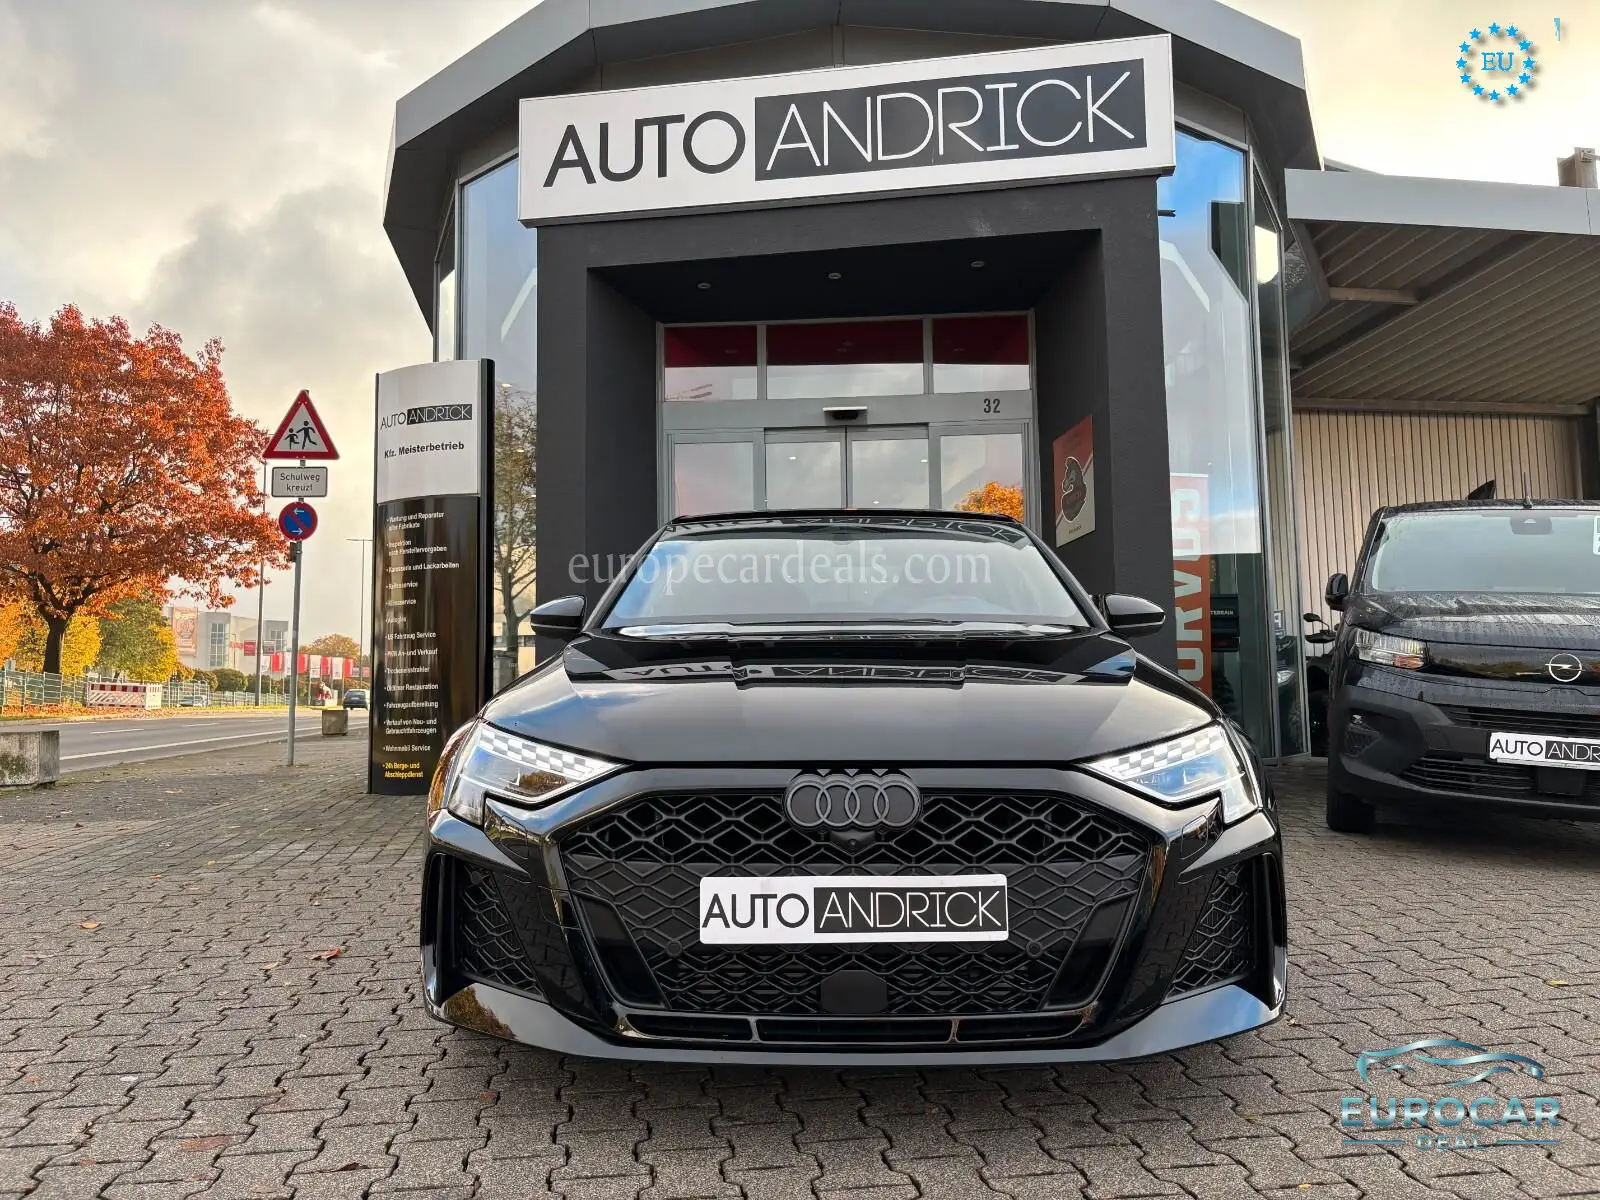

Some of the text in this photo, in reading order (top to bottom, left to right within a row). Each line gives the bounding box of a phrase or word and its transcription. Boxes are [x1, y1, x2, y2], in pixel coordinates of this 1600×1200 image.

[543, 71, 1135, 188] AUTO ANDRICK
[983, 398, 1001, 414] 32
[380, 405, 471, 430] AUTO ANDRICK
[384, 441, 465, 459] Kfz. Meisterbetrieb
[280, 472, 321, 482] Schulweg
[286, 484, 313, 492] kreuzt
[418, 511, 444, 520] Reparatur
[423, 561, 460, 570] Lackarbeiten
[416, 631, 437, 639] Service
[417, 647, 438, 656] Verkauf
[405, 683, 438, 691] Restauration
[426, 717, 437, 725] und
[411, 744, 431, 752] Service
[1490, 738, 1544, 757] AUTO
[409, 761, 420, 769] und
[384, 770, 424, 779] Abschleppdienst
[702, 890, 1002, 929] AUTO ANDRICK
